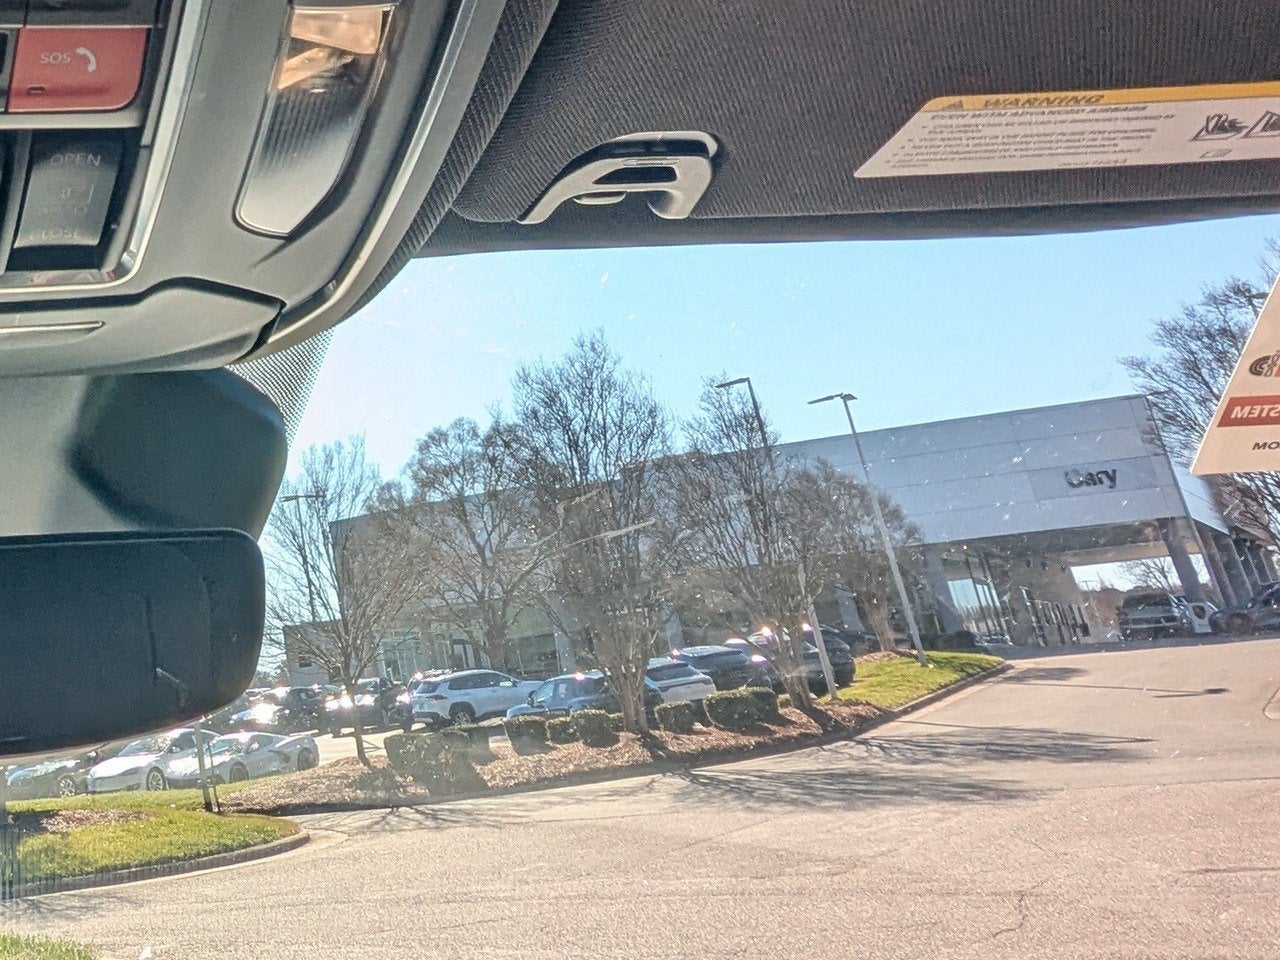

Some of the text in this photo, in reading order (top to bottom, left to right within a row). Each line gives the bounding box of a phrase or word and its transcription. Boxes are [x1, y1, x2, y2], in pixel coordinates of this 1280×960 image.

[41, 53, 71, 65] SOS
[982, 94, 1106, 109] WARNING
[50, 153, 101, 167] OPEN
[1065, 468, 1117, 489] Cary
